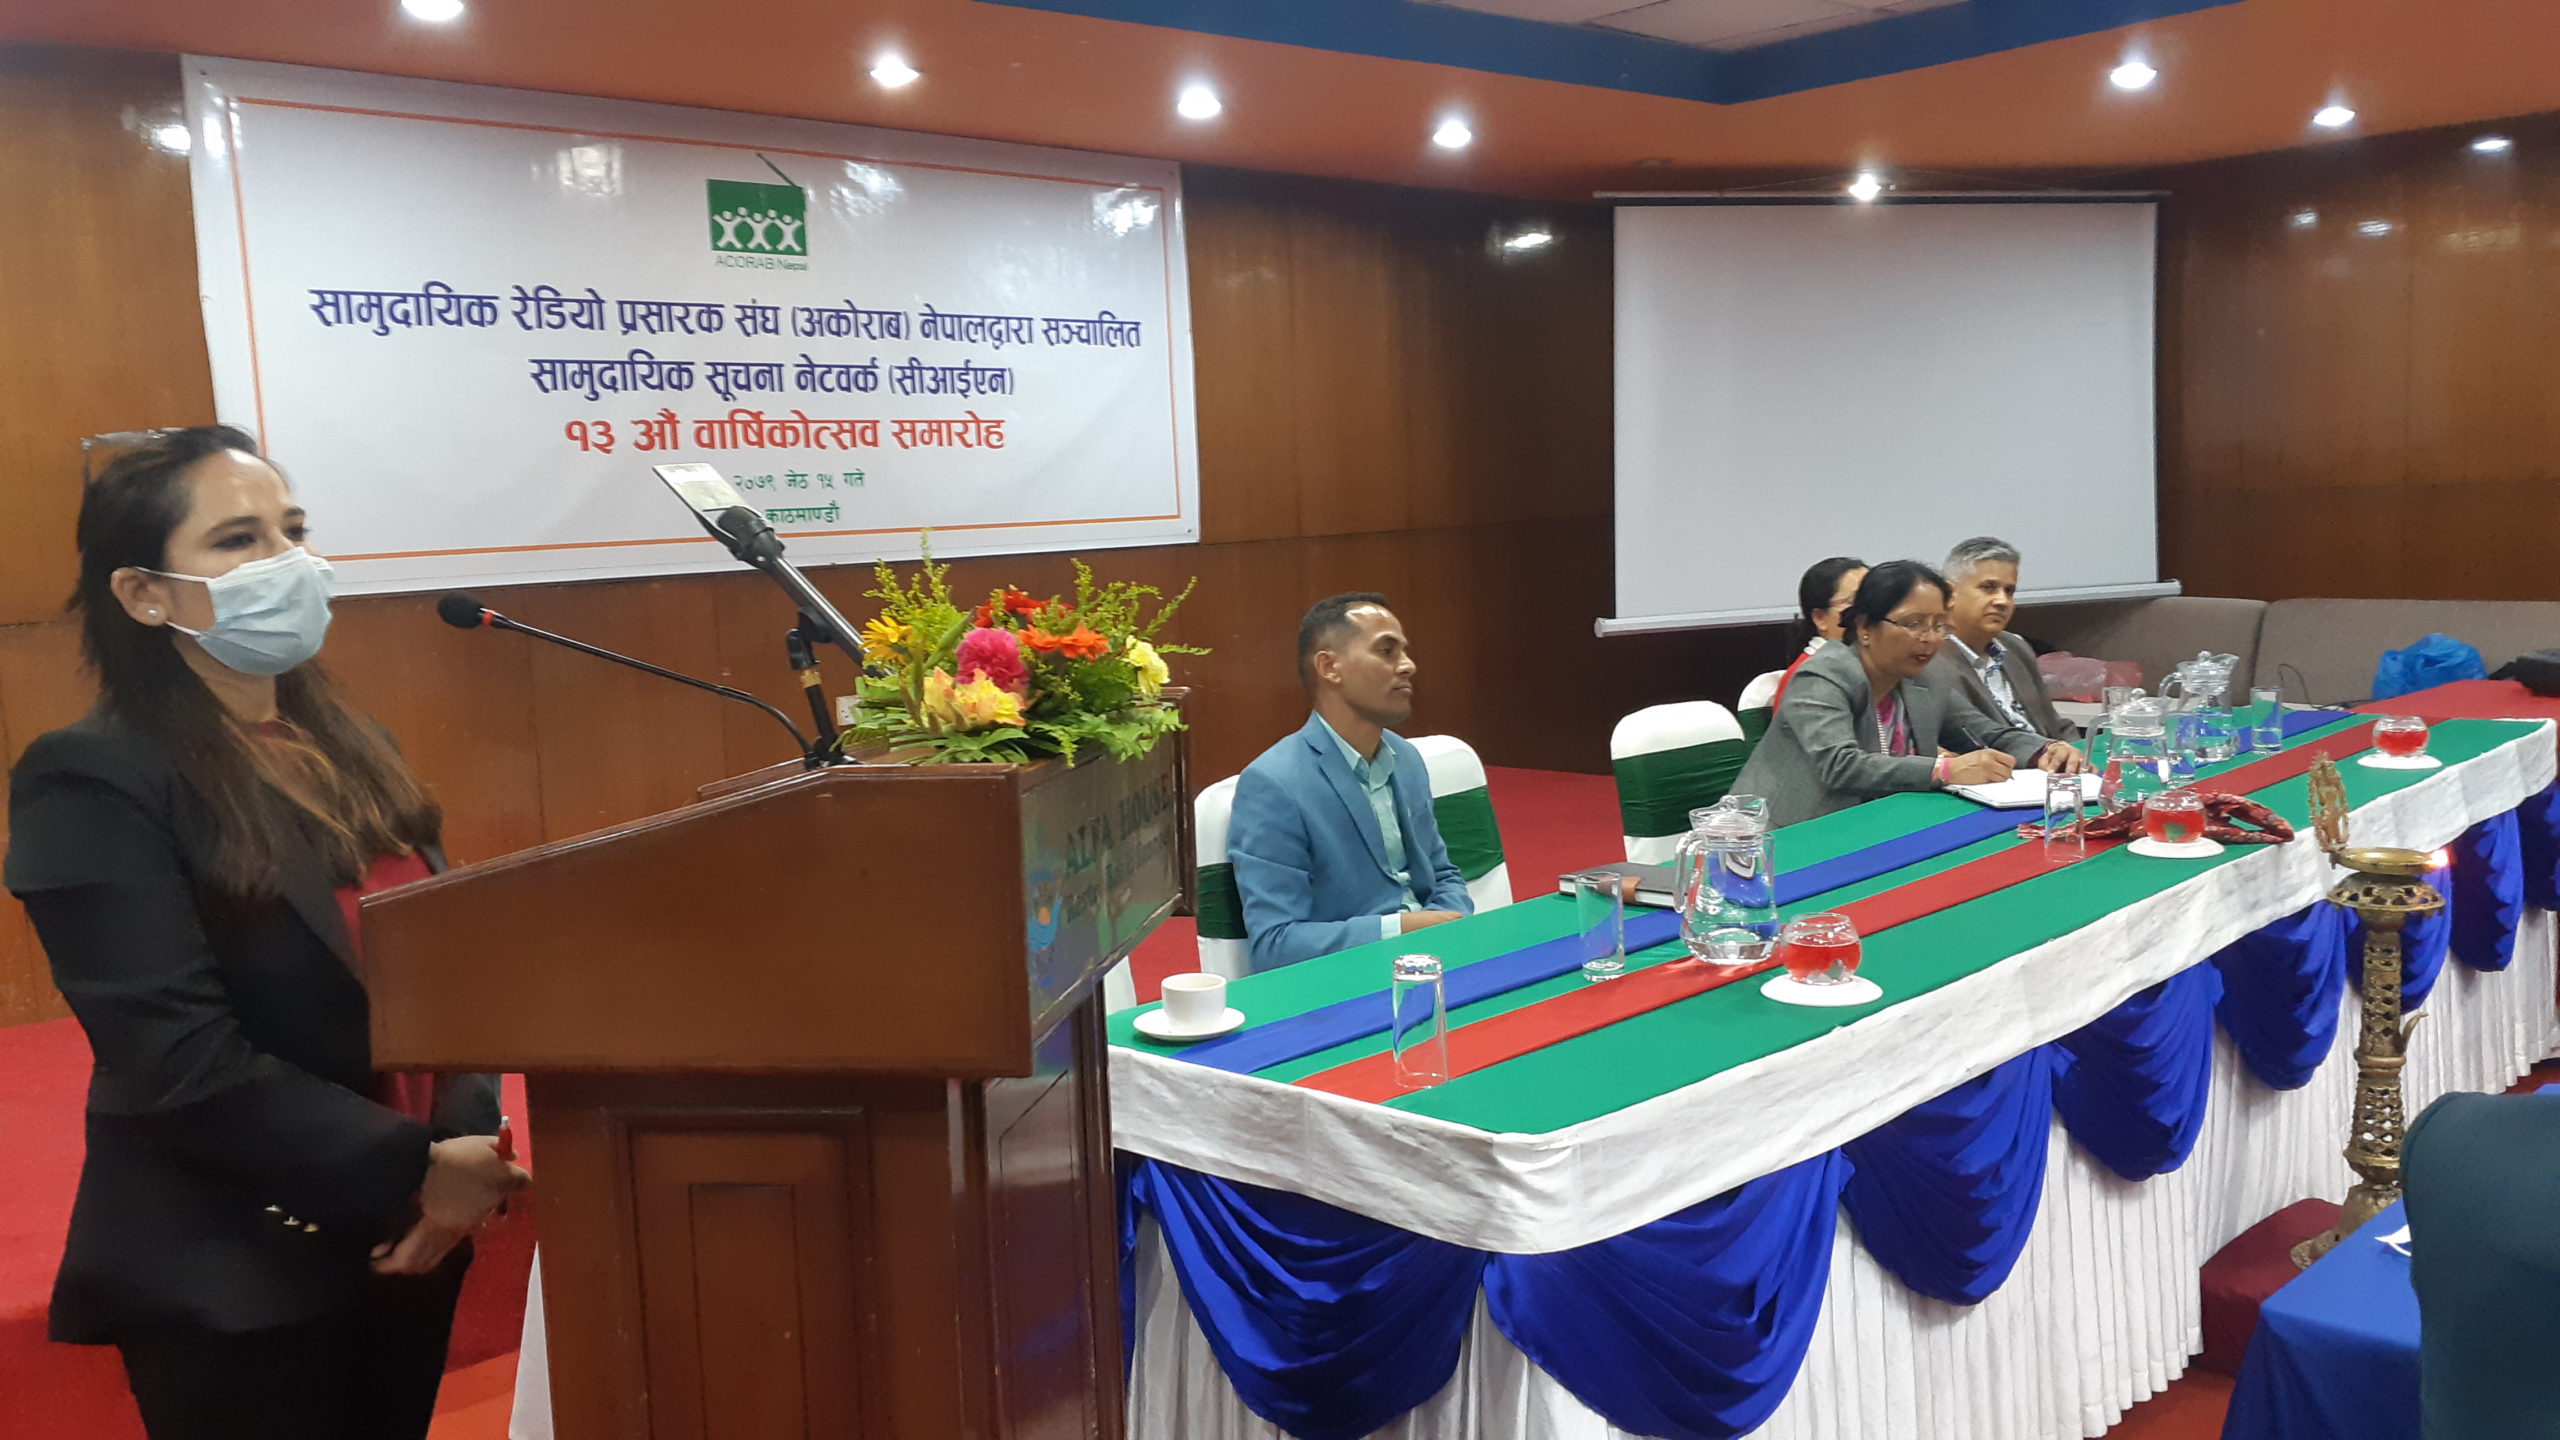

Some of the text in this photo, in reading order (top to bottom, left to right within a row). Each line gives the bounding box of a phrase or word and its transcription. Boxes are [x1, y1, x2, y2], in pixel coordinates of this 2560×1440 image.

[715, 255, 774, 270] ACORAB
[307, 280, 500, 336] सामुदायिक
[510, 284, 606, 331] रेडियो
[615, 299, 725, 335] प्रसारक
[733, 298, 781, 338] संघ
[790, 299, 910, 341] (अकोराब)
[1041, 310, 1142, 348] सञ्चालित
[528, 348, 1015, 402] सामुदायिक सूचना नेटवर्क (सीआईएन)
[564, 418, 616, 454] १३
[692, 407, 880, 451] वार्षिकोत्सव
[890, 409, 1007, 450] समारोह
[733, 474, 776, 492] २०७९
[783, 468, 809, 490] जेठ
[842, 467, 866, 488] गते
